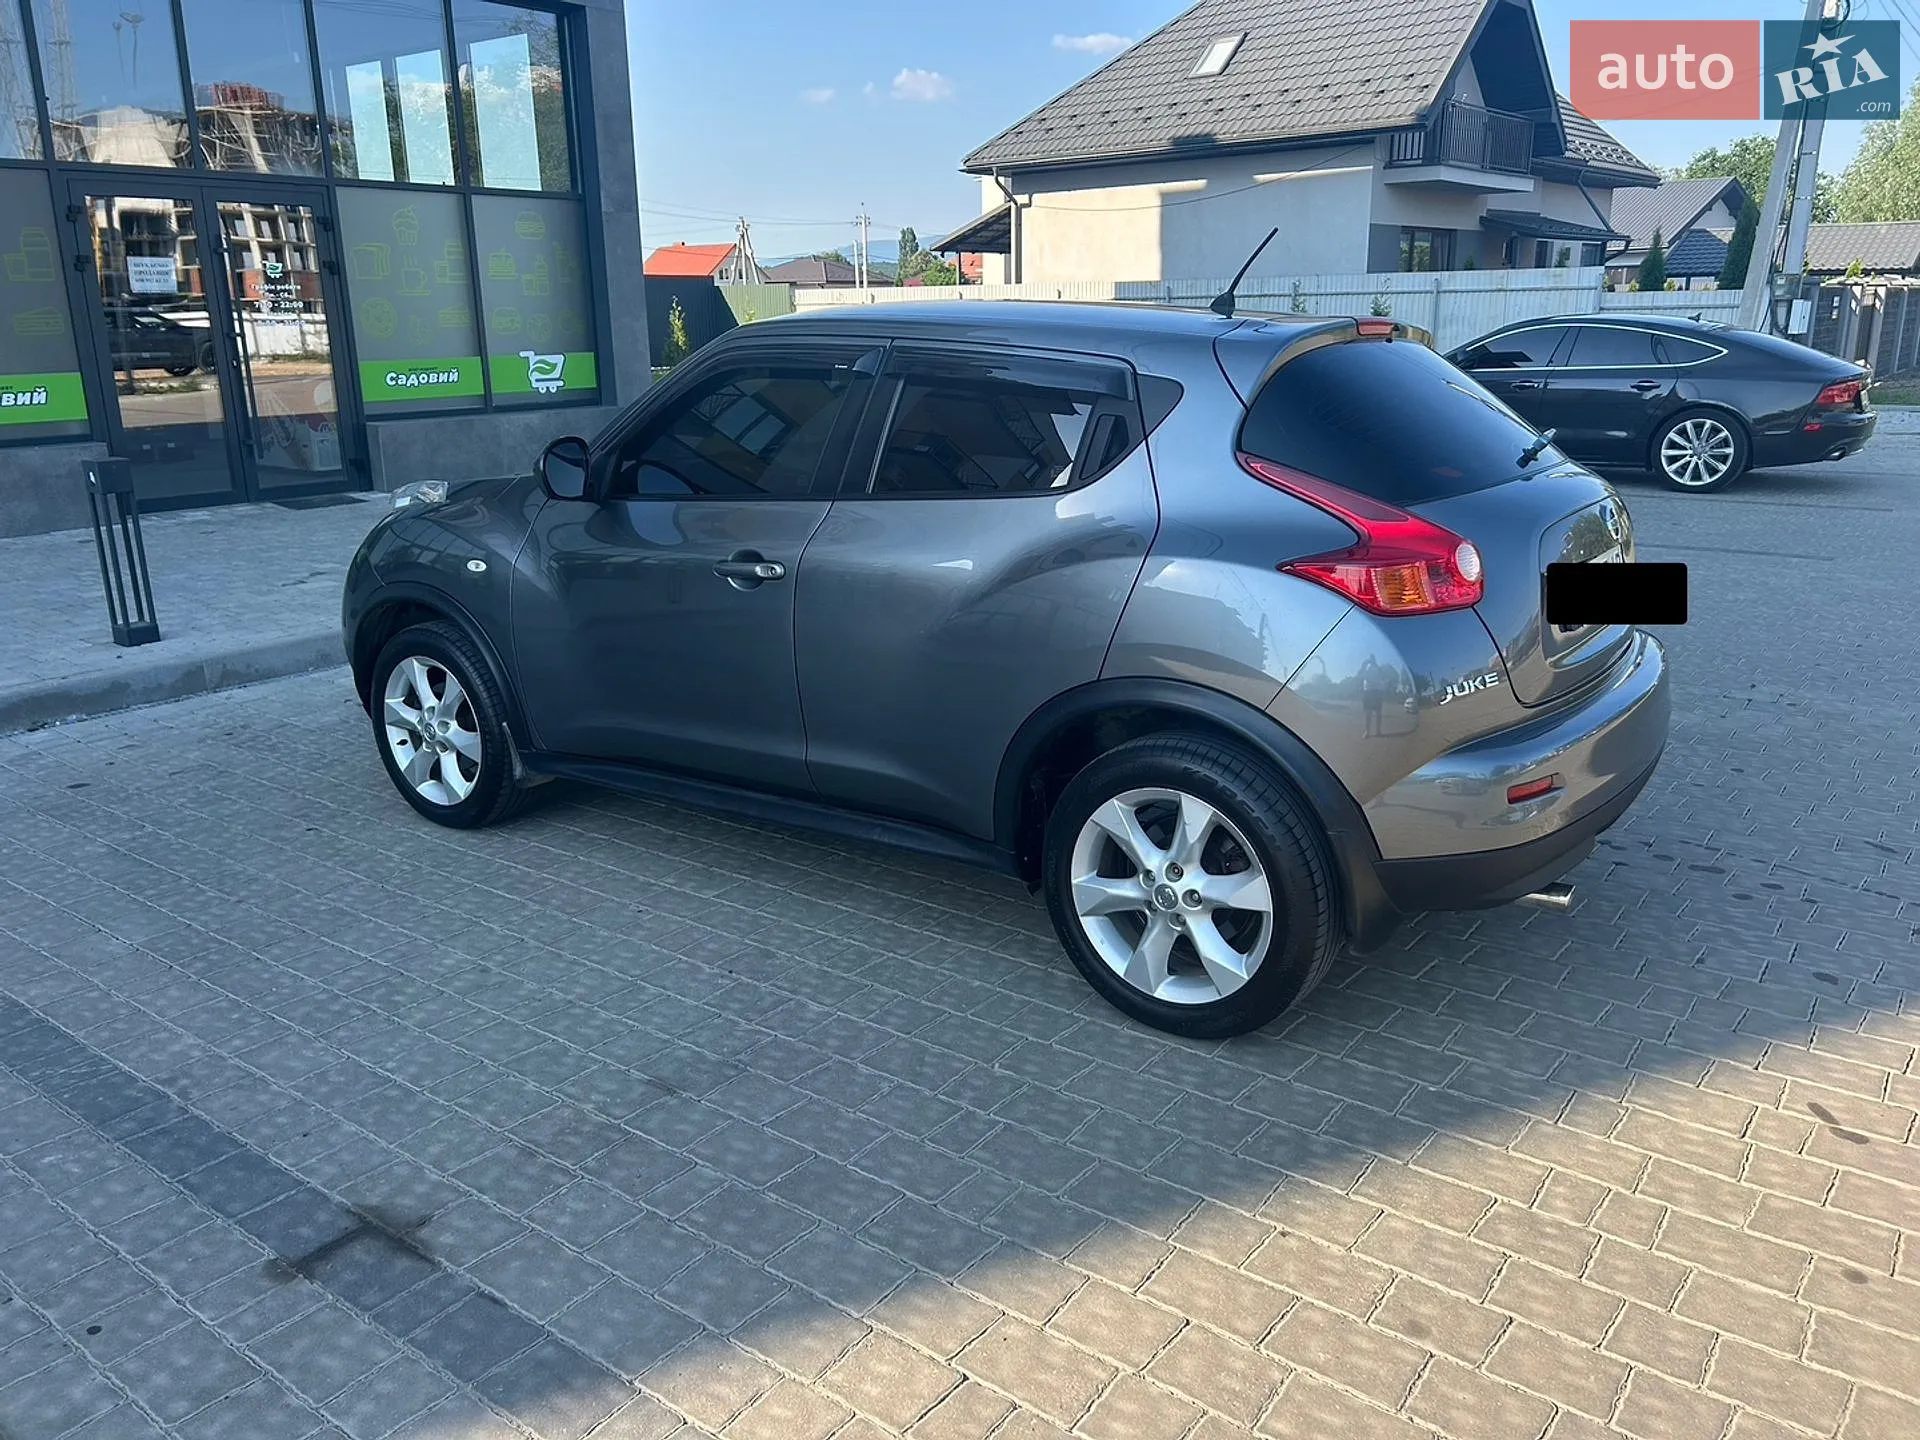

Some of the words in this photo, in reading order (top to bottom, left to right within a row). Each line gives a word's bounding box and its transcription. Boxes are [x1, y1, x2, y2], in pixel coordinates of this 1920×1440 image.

[280, 301, 304, 309] 22:00
[385, 367, 460, 387] Садовий
[1439, 672, 1499, 705] JUKE
